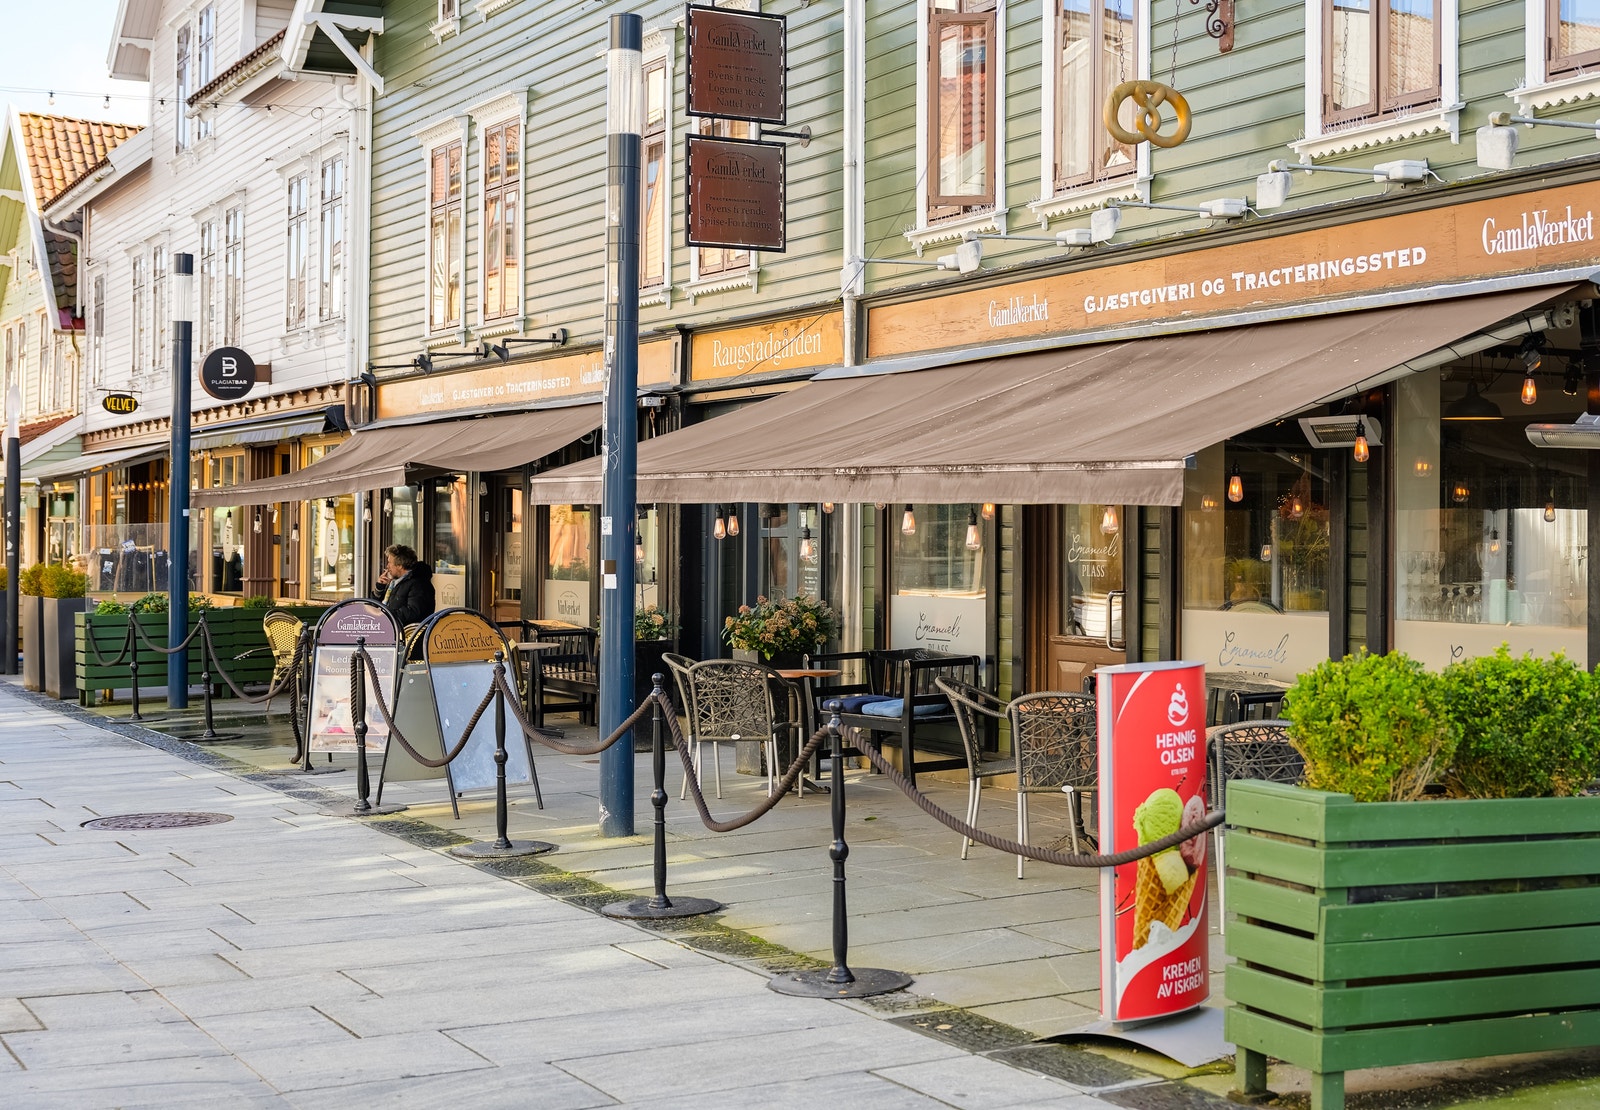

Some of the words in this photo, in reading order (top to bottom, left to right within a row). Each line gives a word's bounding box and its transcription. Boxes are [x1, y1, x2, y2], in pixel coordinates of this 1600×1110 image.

[708, 69, 734, 82] Byens
[705, 203, 731, 215] Byens
[1482, 205, 1594, 256] GamlaVærket
[1084, 282, 1195, 314] GJÆSTGIVERI
[1201, 278, 1225, 297] OG
[1232, 246, 1427, 292] TRACTERINGSSTED
[987, 294, 1048, 327] GamlaVærket
[713, 328, 821, 370] Raugstadgården
[106, 397, 135, 411] VELVET
[1068, 533, 1119, 563] Emanuels
[1082, 564, 1105, 578] PLASS
[337, 619, 381, 631] GamlaVærket
[434, 632, 494, 650] GamlaVærket
[1156, 729, 1196, 749] HENNIG
[1160, 746, 1195, 765] OLSEN
[1162, 955, 1201, 981] KREMEN
[1156, 982, 1173, 999] AV
[1174, 970, 1204, 995] ISKREM
